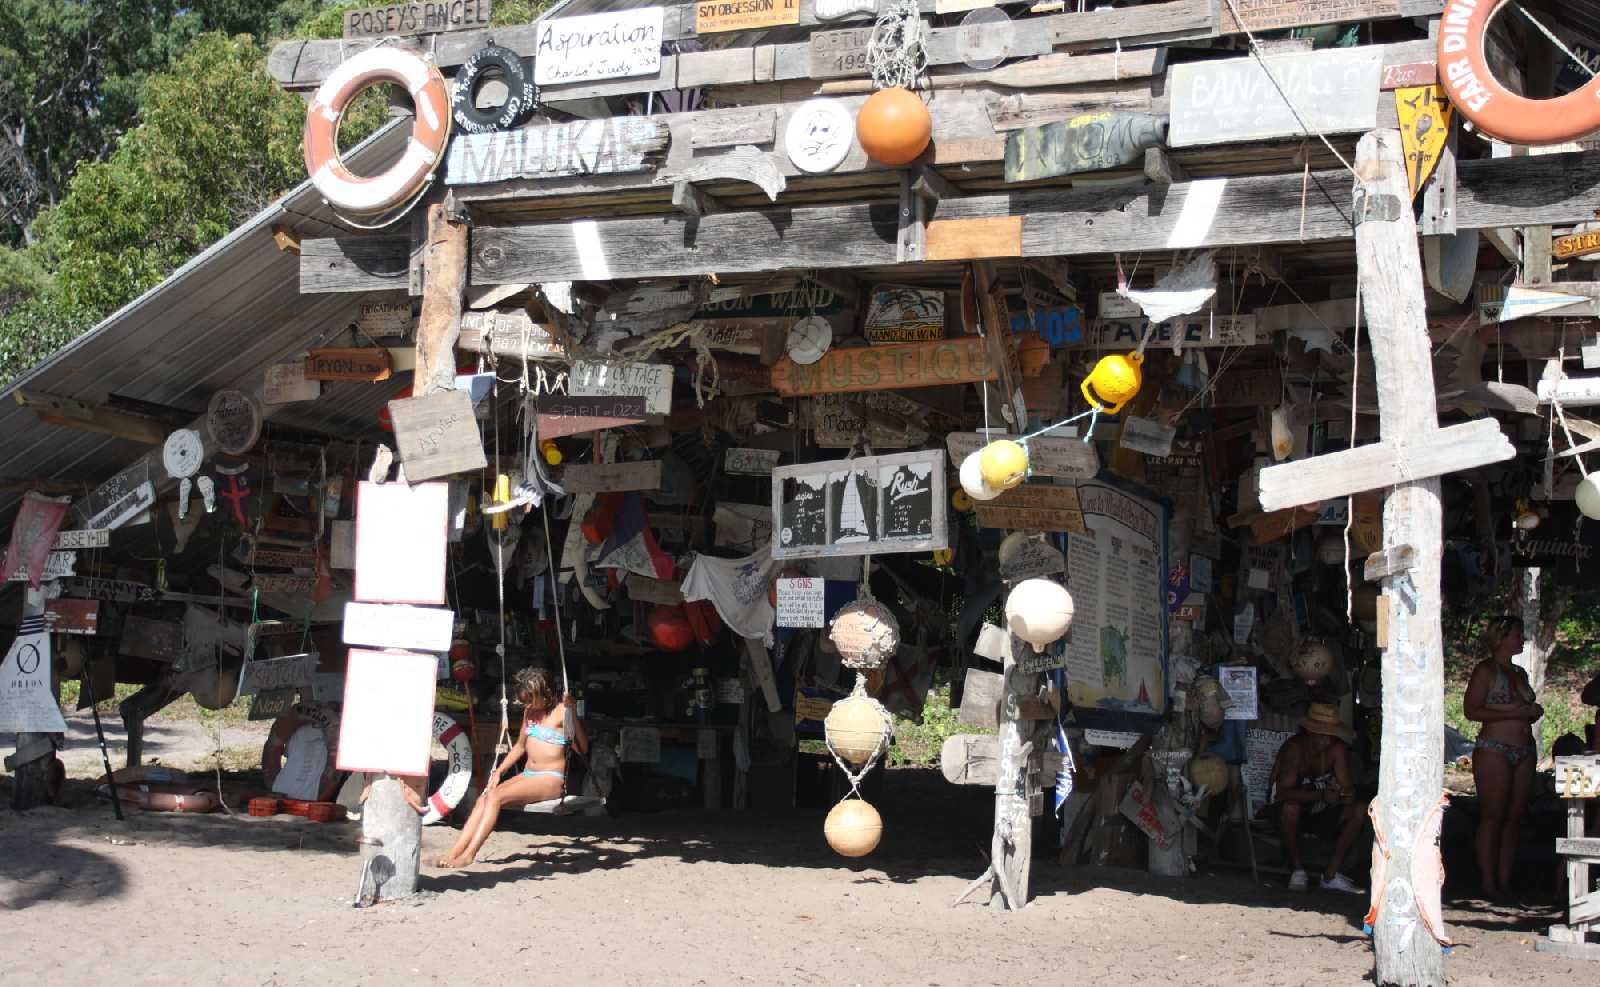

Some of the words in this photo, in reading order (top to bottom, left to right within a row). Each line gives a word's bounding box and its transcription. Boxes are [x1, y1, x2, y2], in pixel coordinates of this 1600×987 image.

[351, 5, 418, 34] ROSEY'S
[424, 0, 487, 27] ANGEL
[719, 0, 774, 16] OBSESSION
[1443, 0, 1478, 54] DIN
[538, 23, 656, 59] Aspiration
[1447, 57, 1493, 112] FAIR
[788, 343, 993, 390] MUSTIQU
